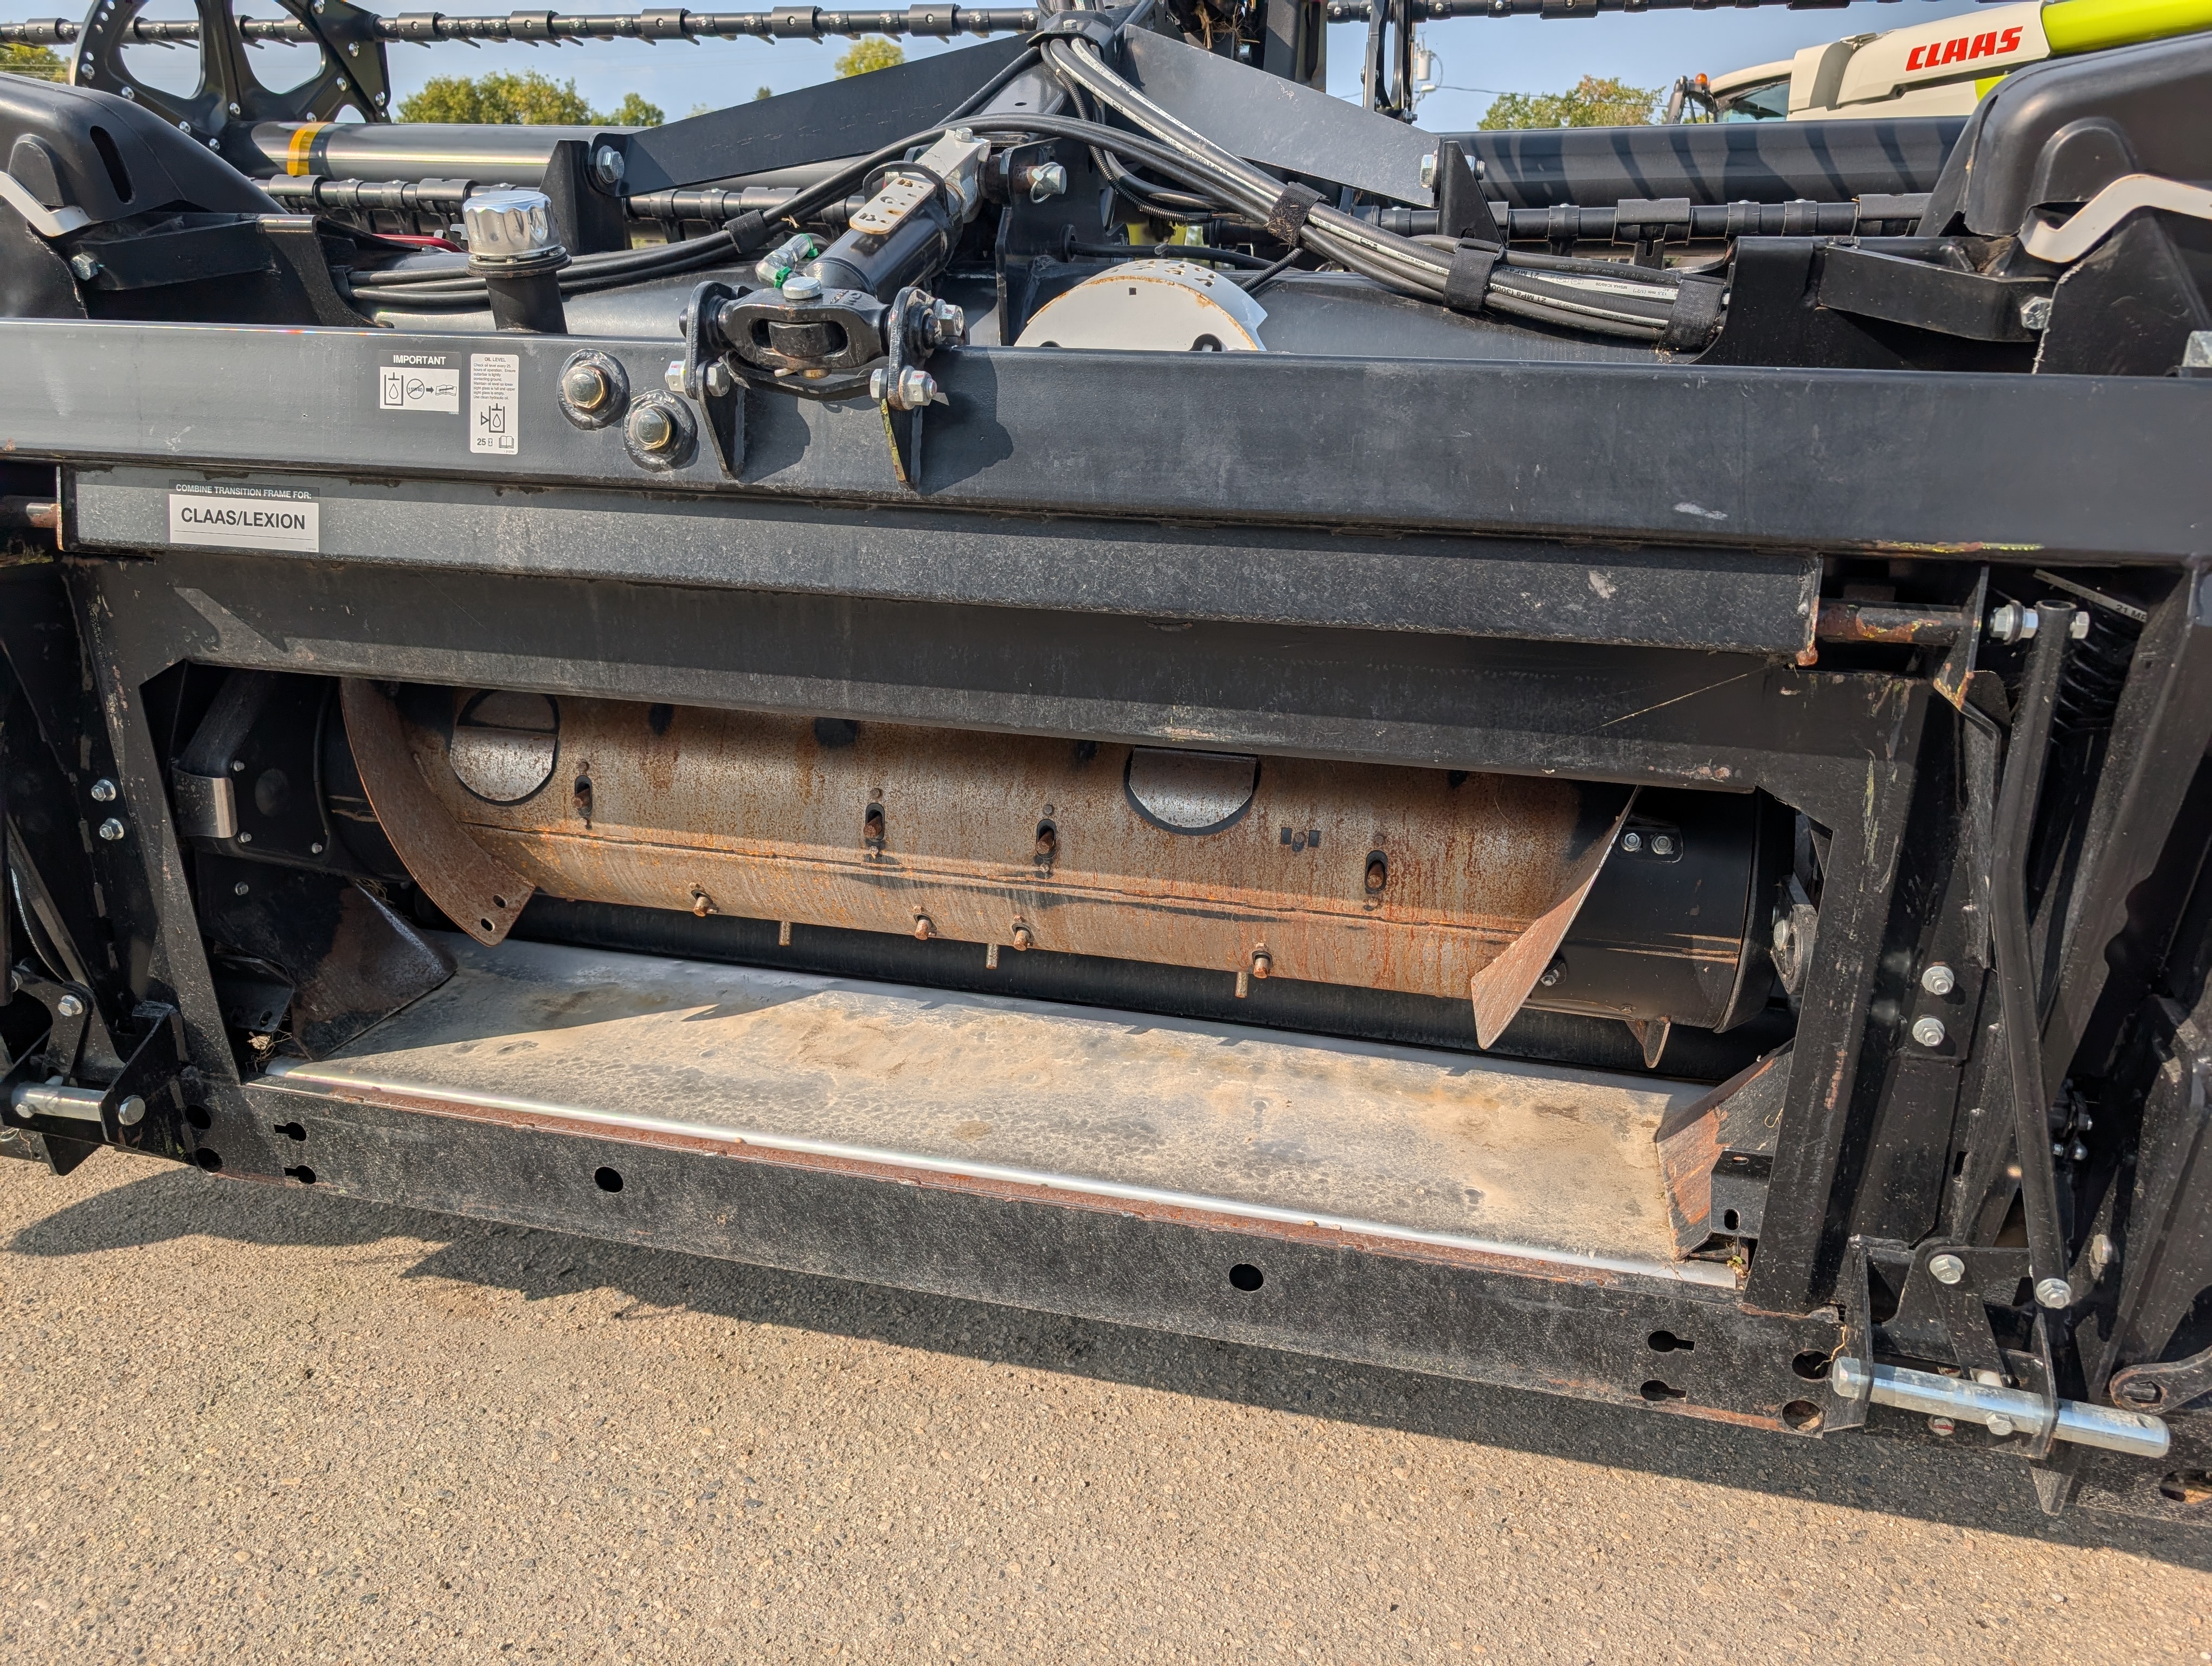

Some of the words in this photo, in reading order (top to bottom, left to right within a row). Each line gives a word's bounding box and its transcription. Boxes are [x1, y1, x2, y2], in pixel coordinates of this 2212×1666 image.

[1906, 26, 2023, 71] CLAAS
[1491, 285, 1514, 296] (3000
[1516, 291, 1534, 300] MPa
[393, 355, 446, 365] IMPORTANT
[477, 438, 486, 446] 25
[176, 484, 213, 494] COMBINE
[214, 486, 261, 497] TRANSITION
[263, 489, 291, 498] FRAME
[293, 491, 312, 499] FOR:
[181, 507, 305, 530] CLAAS/LEXION
